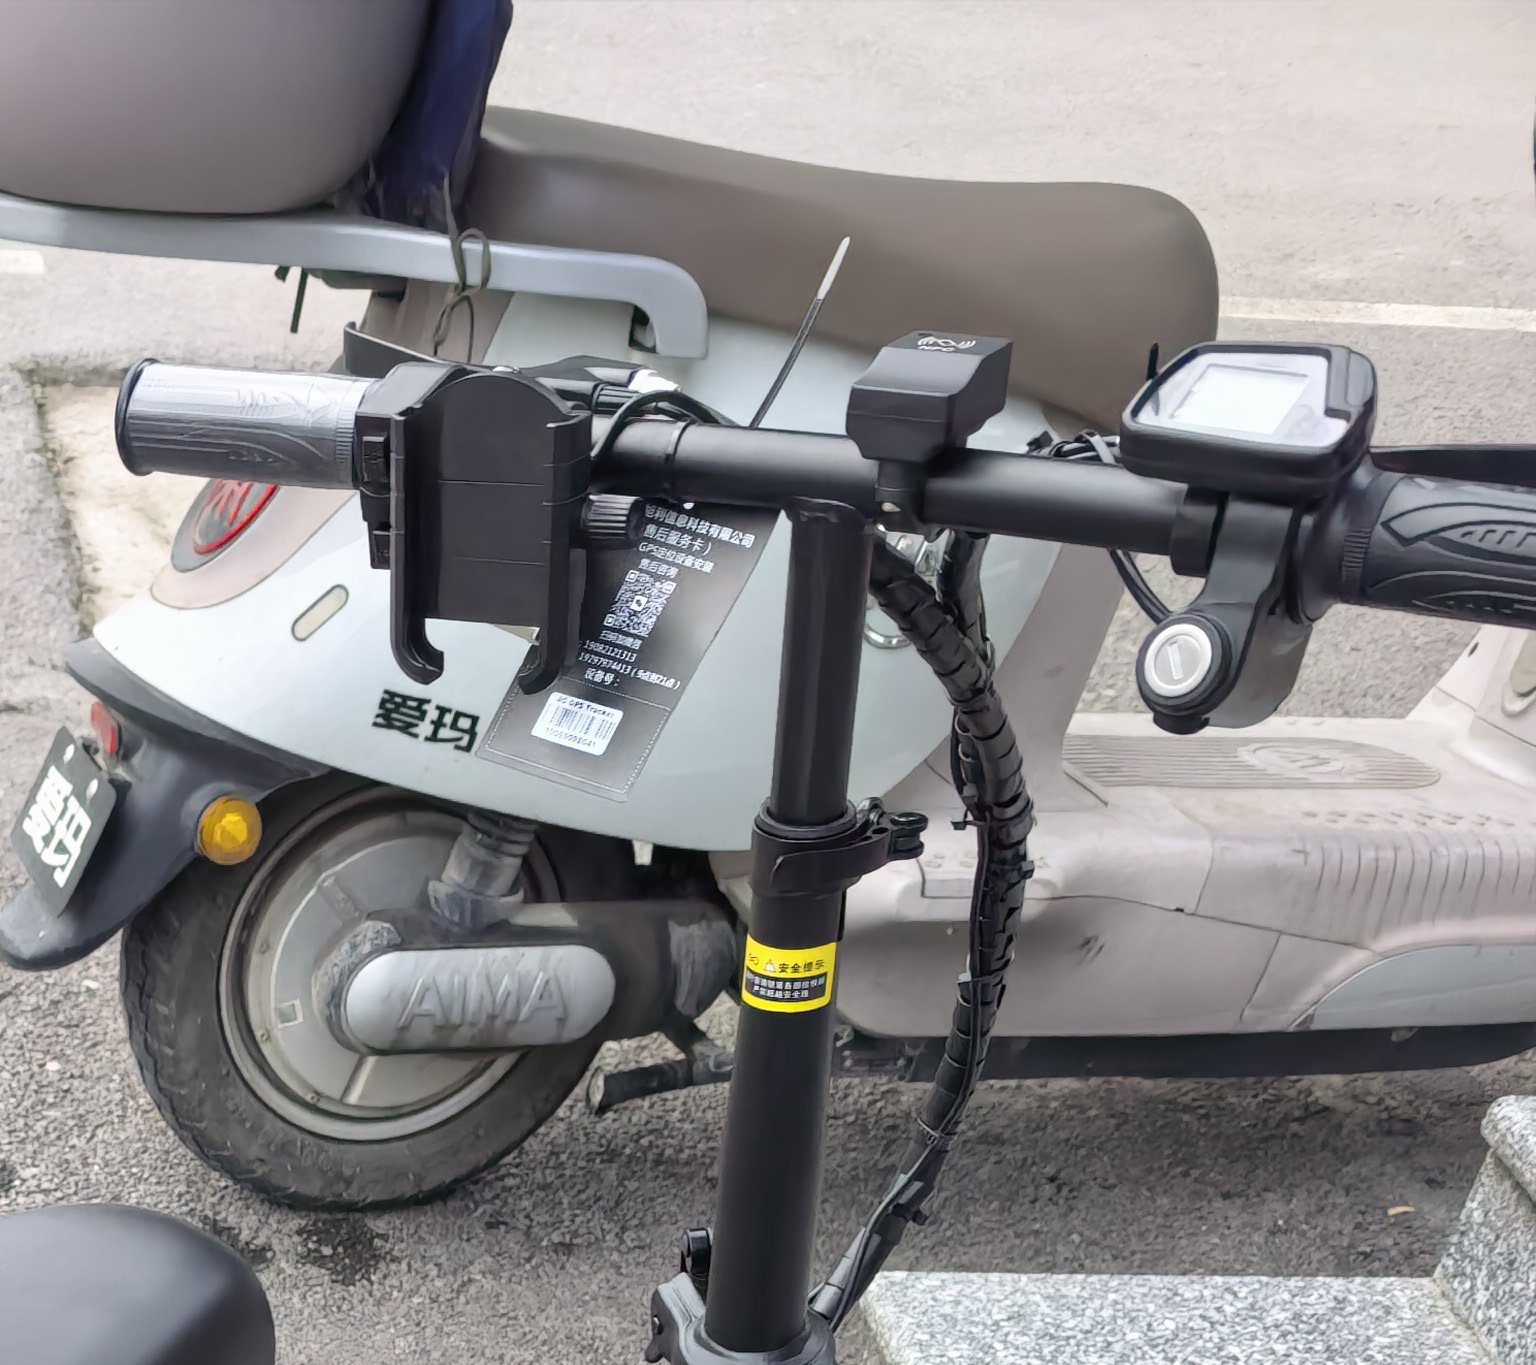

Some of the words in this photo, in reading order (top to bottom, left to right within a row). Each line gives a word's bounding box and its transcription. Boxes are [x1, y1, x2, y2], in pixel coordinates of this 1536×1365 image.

[371, 688, 481, 753] 爱玛
[21, 763, 93, 889] 爱玛
[398, 969, 569, 1031] AIMA
